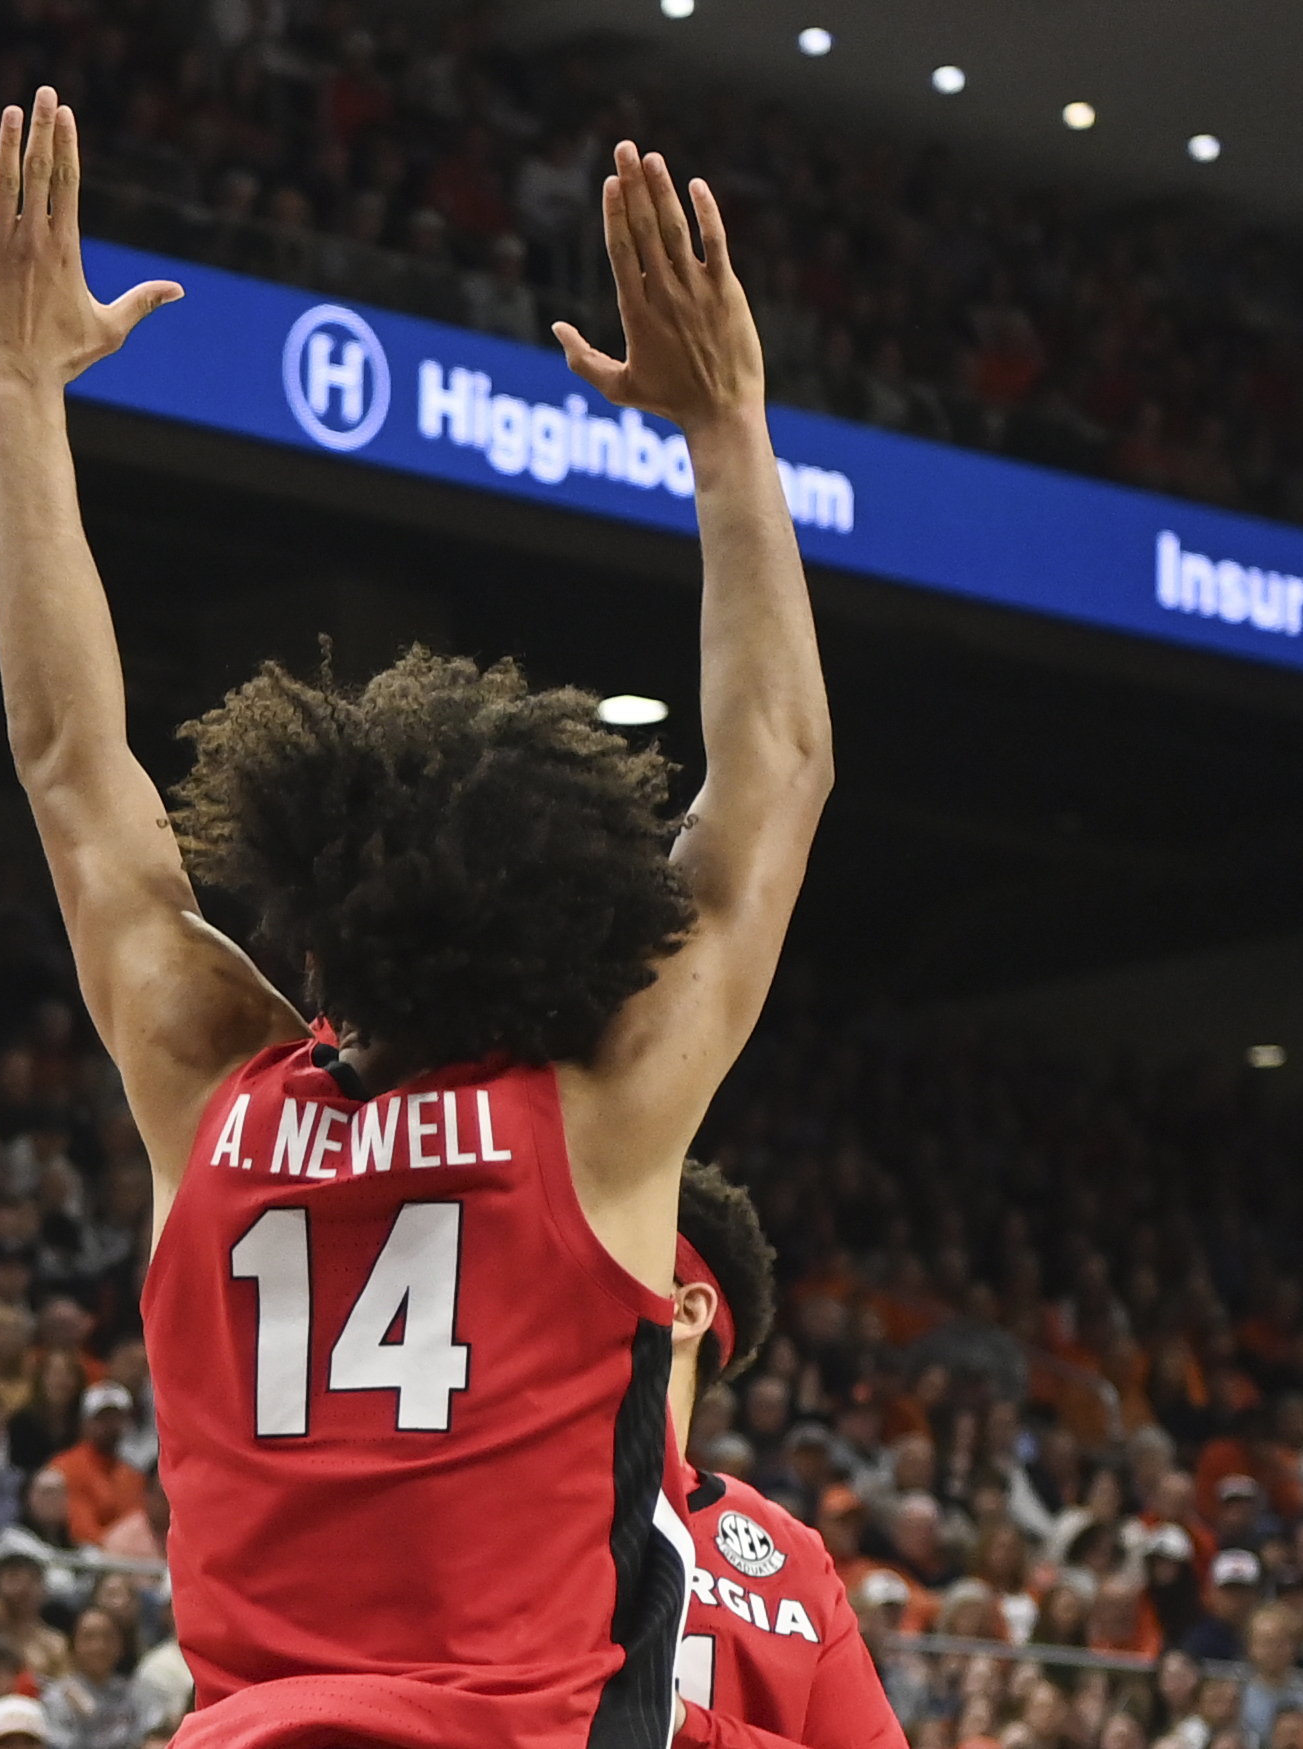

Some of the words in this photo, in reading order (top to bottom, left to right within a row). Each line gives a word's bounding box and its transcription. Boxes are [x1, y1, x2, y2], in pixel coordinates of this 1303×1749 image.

[419, 359, 854, 533] Higginbom
[210, 1093, 253, 1170] A.
[269, 1088, 512, 1179] NEWELL
[229, 1199, 472, 1440] 14
[720, 1513, 772, 1561] SEC
